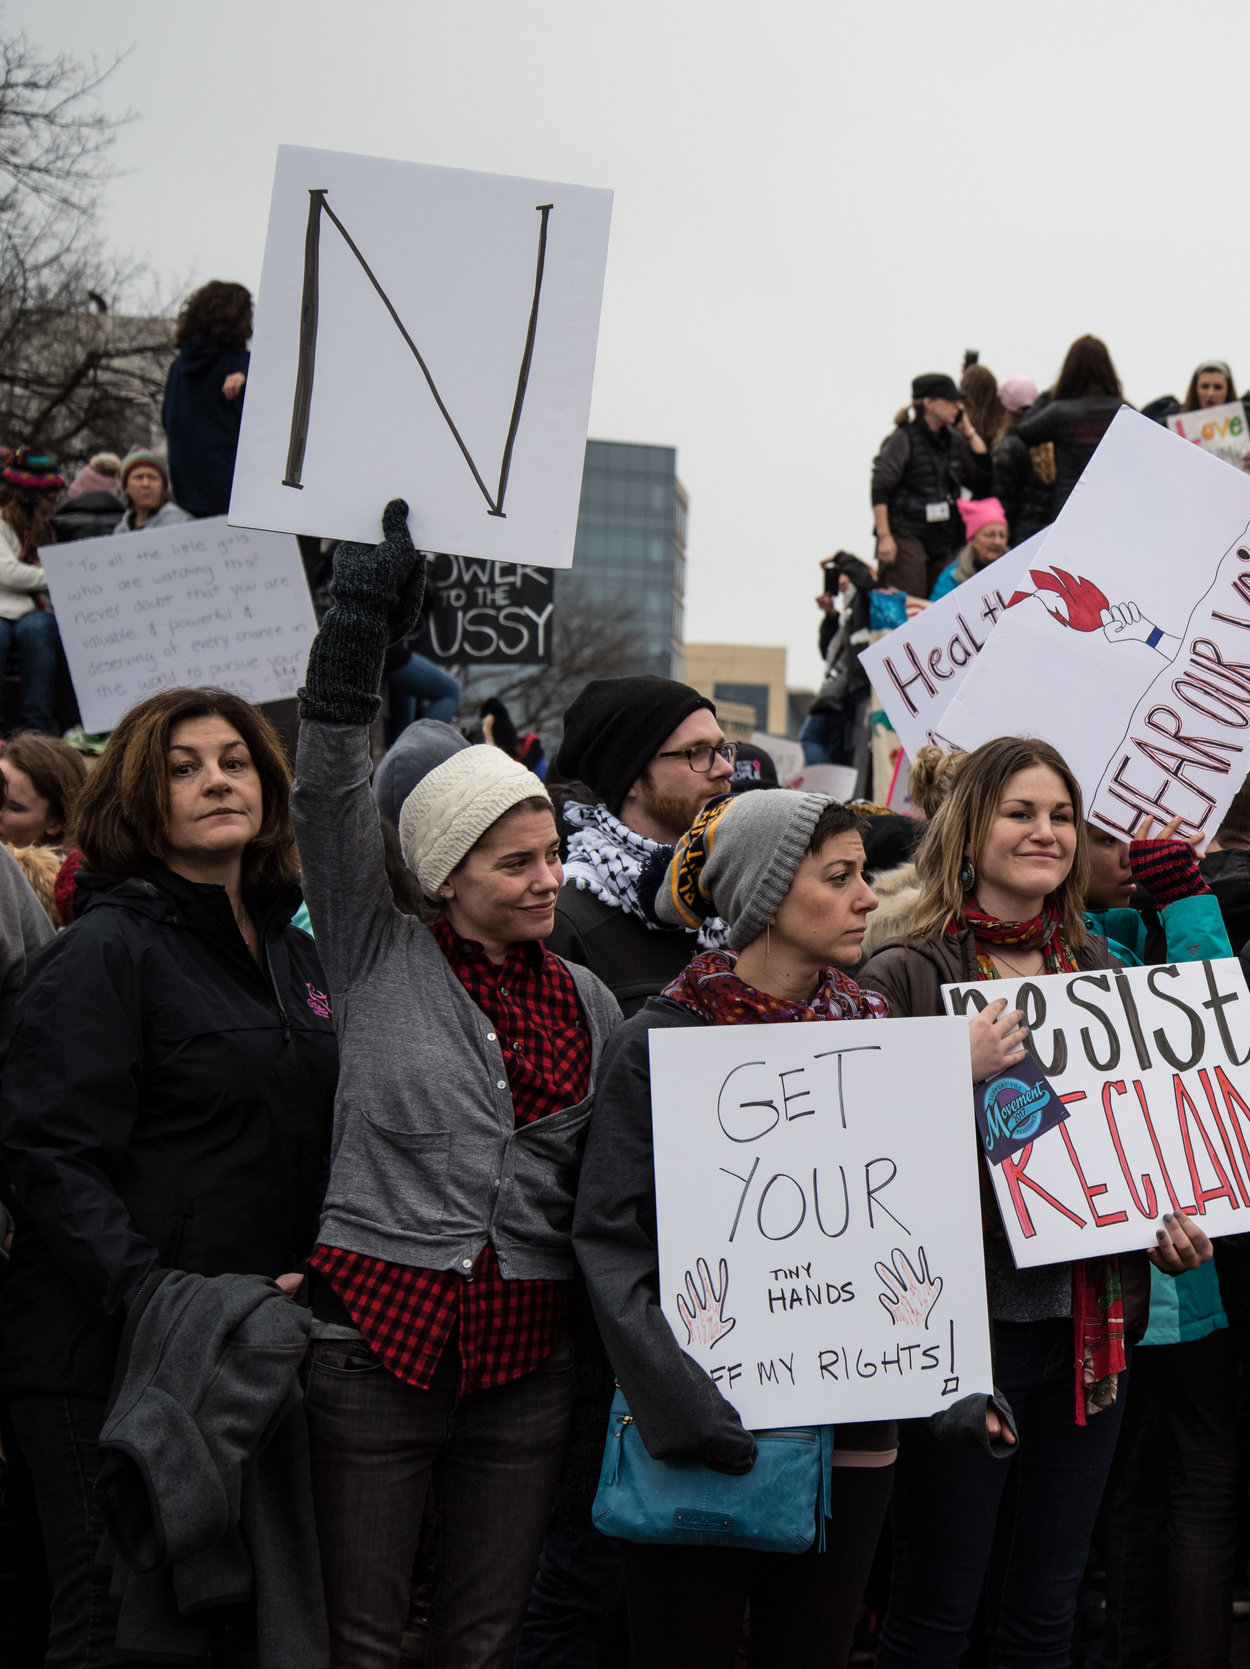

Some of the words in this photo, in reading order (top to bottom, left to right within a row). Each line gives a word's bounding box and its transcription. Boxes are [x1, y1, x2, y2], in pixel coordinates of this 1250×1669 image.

[282, 189, 554, 518] N
[108, 553, 124, 568] all
[136, 549, 161, 561] the
[171, 539, 207, 554] little
[435, 553, 549, 589] OWER
[67, 584, 103, 602] who
[118, 578, 142, 591] are
[152, 565, 215, 586] watching
[74, 604, 120, 626] never
[134, 594, 174, 613] doubt
[187, 585, 219, 600] that
[229, 581, 257, 601] you
[264, 577, 288, 591] are
[441, 588, 467, 607] TO
[474, 585, 511, 607] THE
[81, 627, 137, 649] valuable
[169, 606, 232, 636] powerful
[88, 653, 158, 677] deserving
[163, 640, 177, 658] of
[191, 635, 228, 653] every
[236, 626, 283, 642] chance
[291, 623, 306, 633] in
[882, 589, 1007, 719] Healt
[96, 682, 127, 698] the
[139, 670, 176, 691] world
[210, 658, 259, 680] pursue
[1092, 704, 1243, 839] HEAR
[717, 1045, 882, 1143] GET
[986, 1080, 1044, 1151] Movement
[1013, 1108, 1027, 1124] 2017
[719, 1157, 912, 1243] YOUR
[769, 1262, 812, 1281] TINY
[768, 1281, 856, 1314] HANDS
[757, 1353, 798, 1386] MY
[818, 1319, 960, 1396] RIGHTS!
